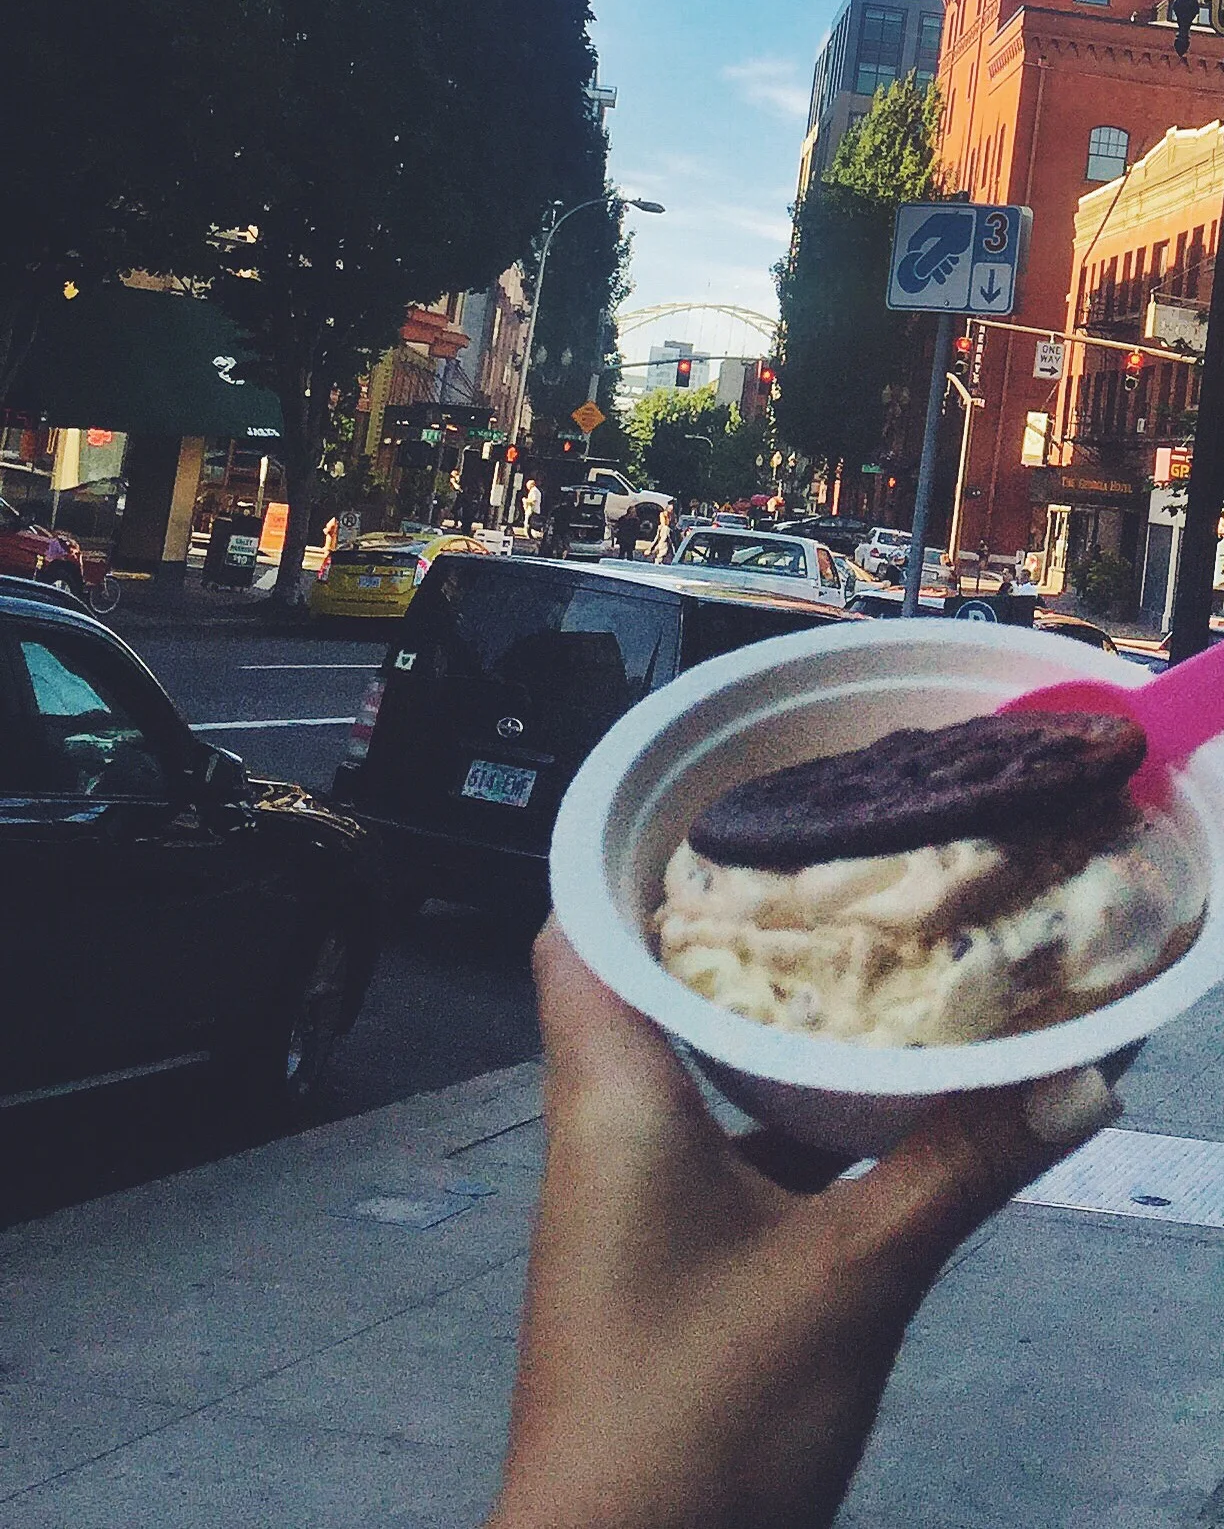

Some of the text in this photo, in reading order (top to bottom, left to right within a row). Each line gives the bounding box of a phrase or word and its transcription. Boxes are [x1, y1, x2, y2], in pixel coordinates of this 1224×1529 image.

[983, 211, 1010, 254] 3
[1042, 344, 1061, 355] ONE
[1040, 354, 1061, 364] WAY
